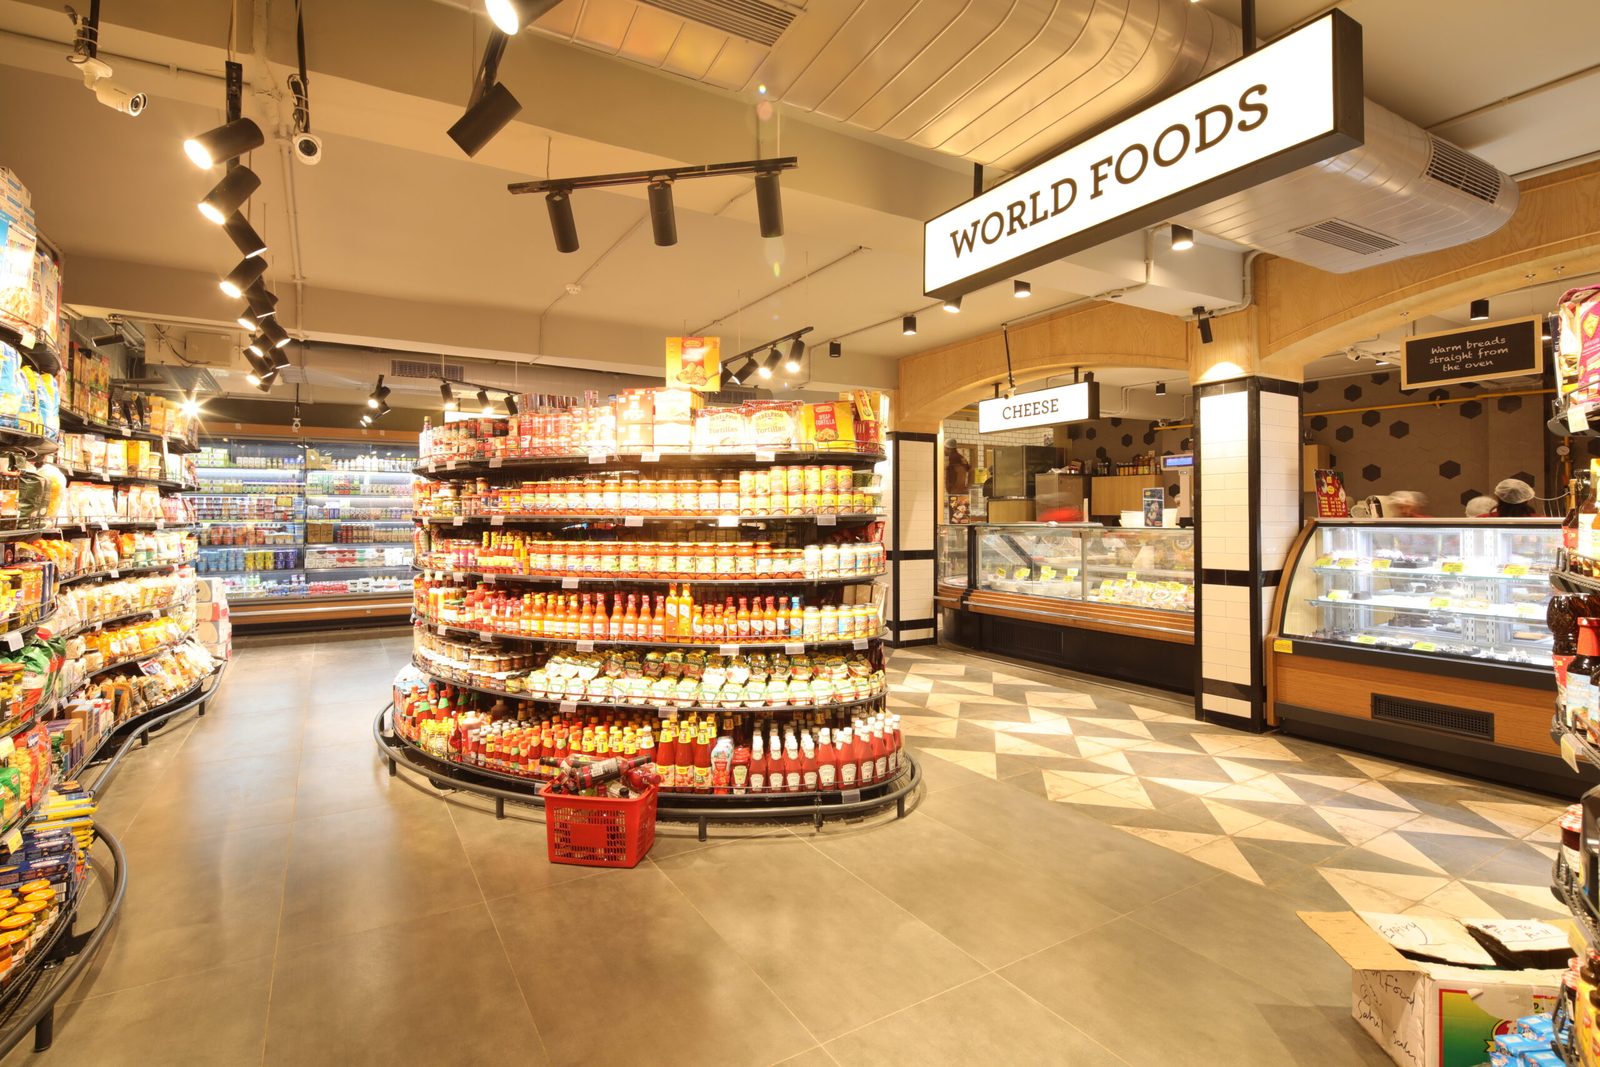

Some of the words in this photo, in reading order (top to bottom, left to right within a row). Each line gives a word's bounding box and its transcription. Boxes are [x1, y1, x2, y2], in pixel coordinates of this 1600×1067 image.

[949, 177, 1077, 259] WORLD
[1089, 83, 1268, 200] FOODS
[1431, 344, 1462, 355] Warm
[1466, 336, 1506, 350] breads
[1429, 350, 1473, 364] straight
[1477, 347, 1509, 360] from
[1442, 363, 1460, 372] the
[1465, 359, 1494, 369] oven
[1002, 398, 1059, 420] CHEESE
